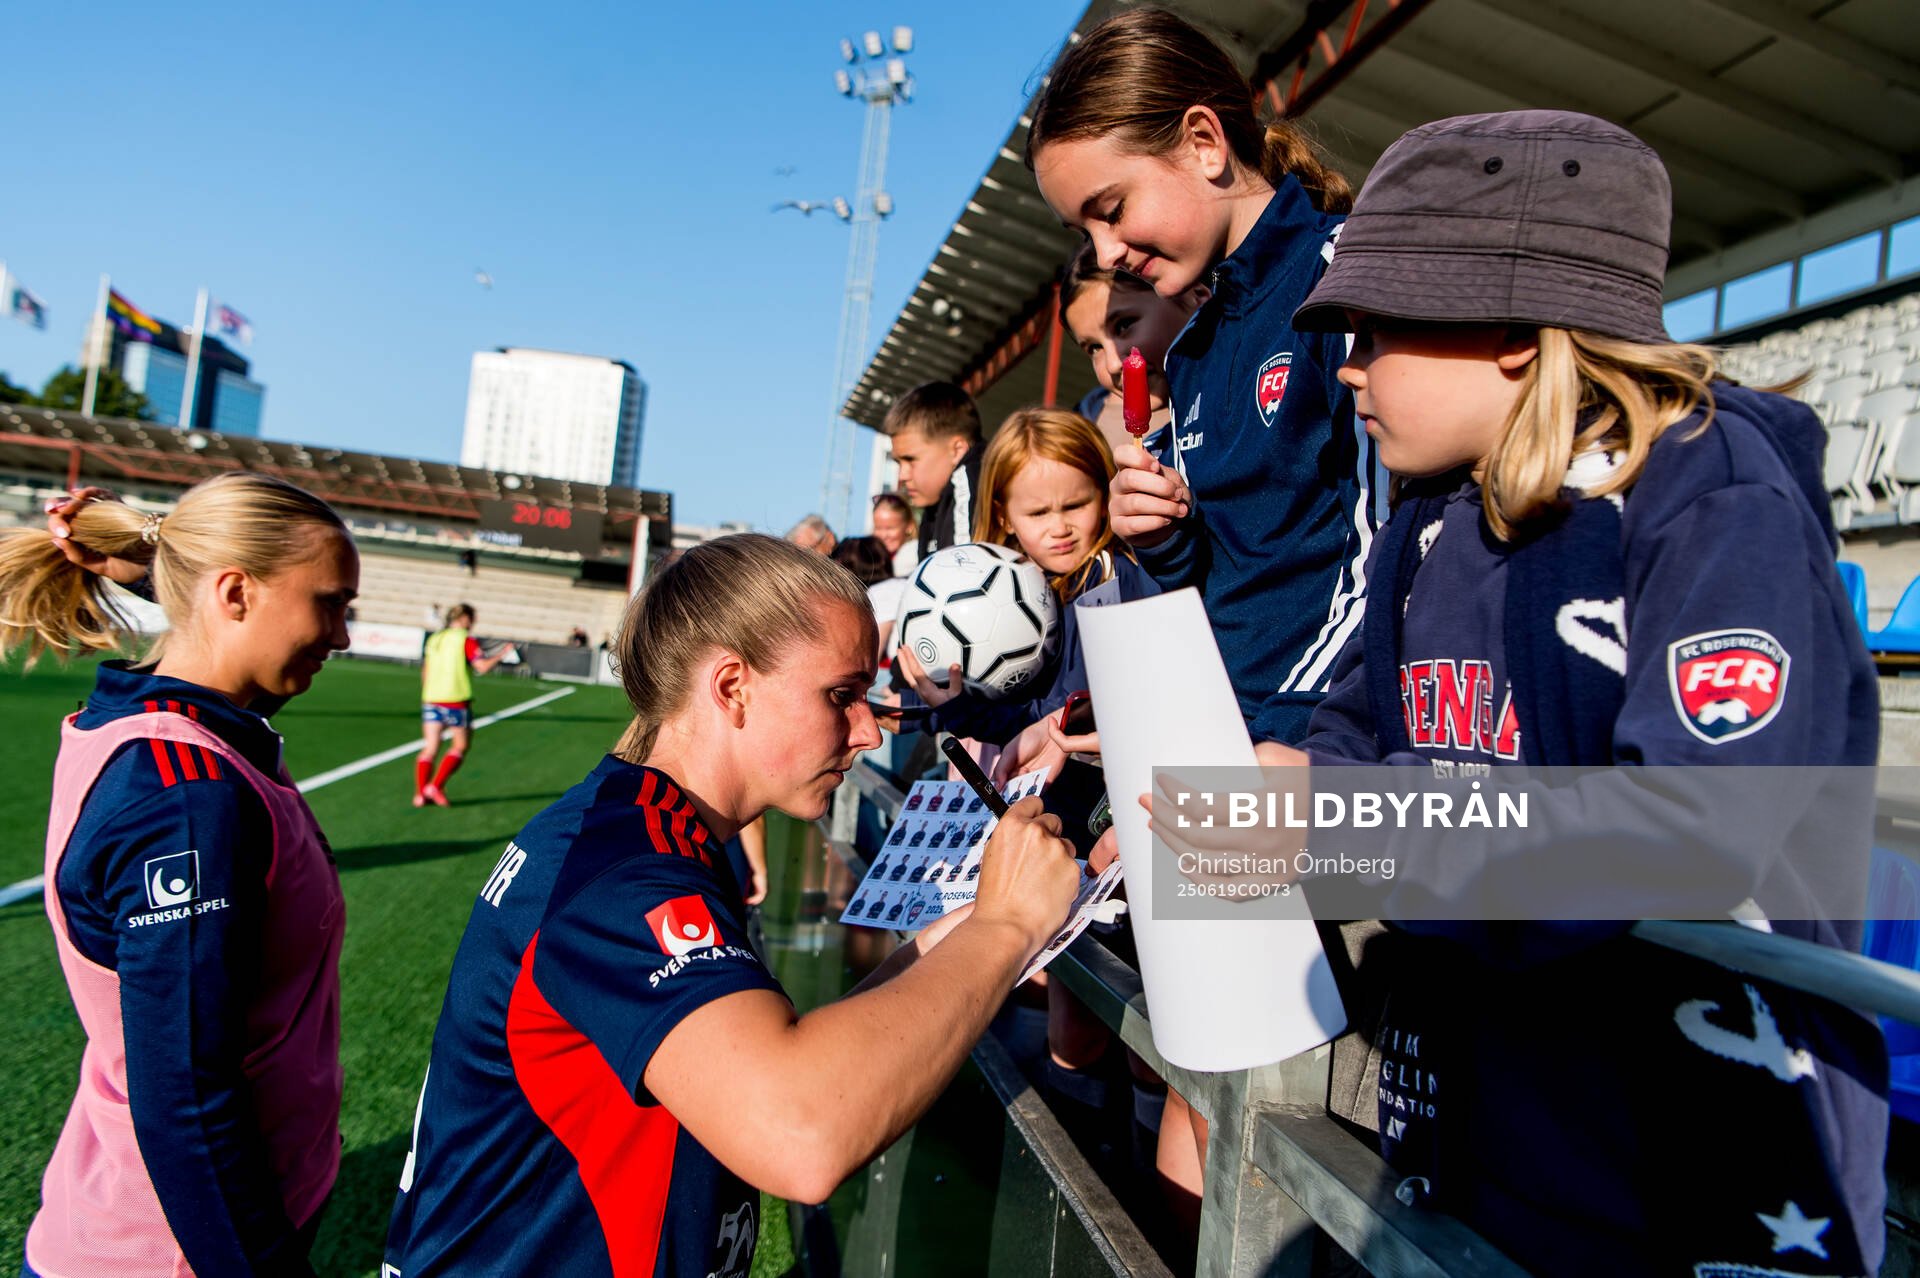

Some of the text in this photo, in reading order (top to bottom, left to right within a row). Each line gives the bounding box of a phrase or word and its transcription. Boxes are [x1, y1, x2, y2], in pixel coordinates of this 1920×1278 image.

[1680, 644, 1701, 659] FC
[1685, 657, 1777, 693] FCR
[128, 898, 230, 928] SVENSKA SPEL
